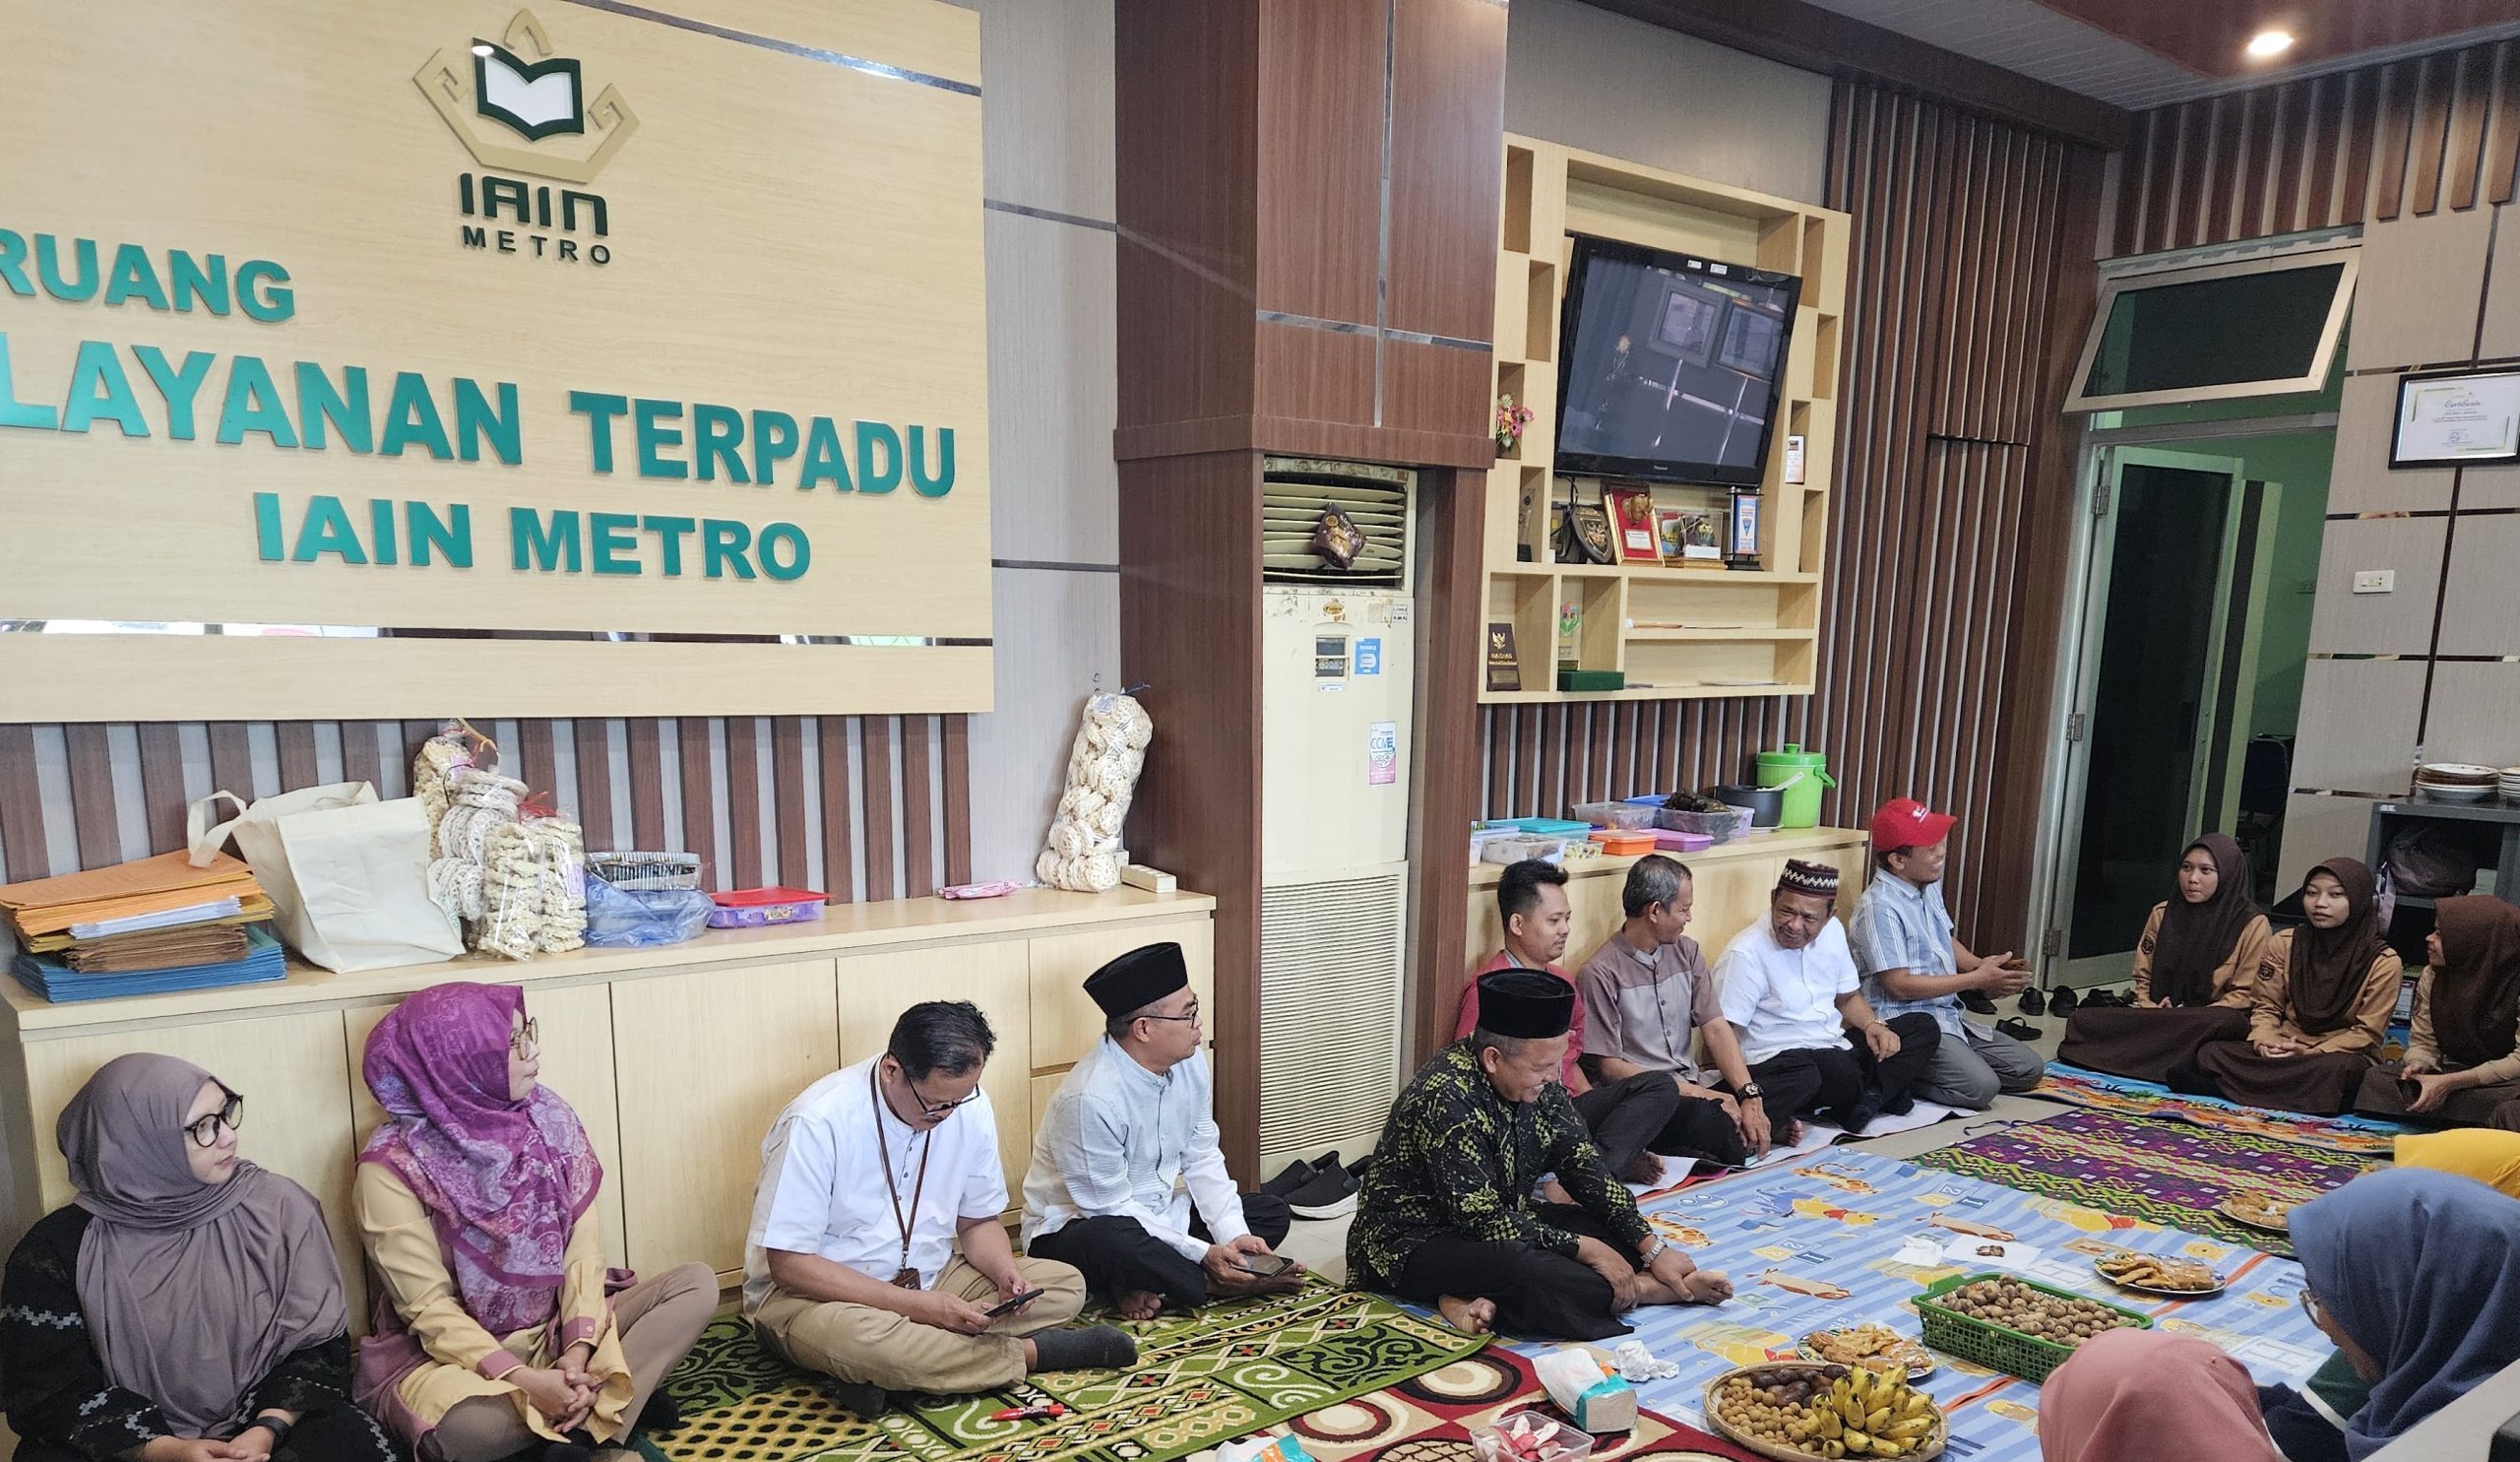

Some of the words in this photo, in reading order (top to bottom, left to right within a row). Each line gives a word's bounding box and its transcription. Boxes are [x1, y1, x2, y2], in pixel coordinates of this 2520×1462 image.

[0, 228, 295, 323] RUANG
[462, 225, 611, 265] METRO
[569, 390, 956, 498] TERPADU
[253, 492, 474, 569] IAIN
[510, 506, 812, 582] METRO
